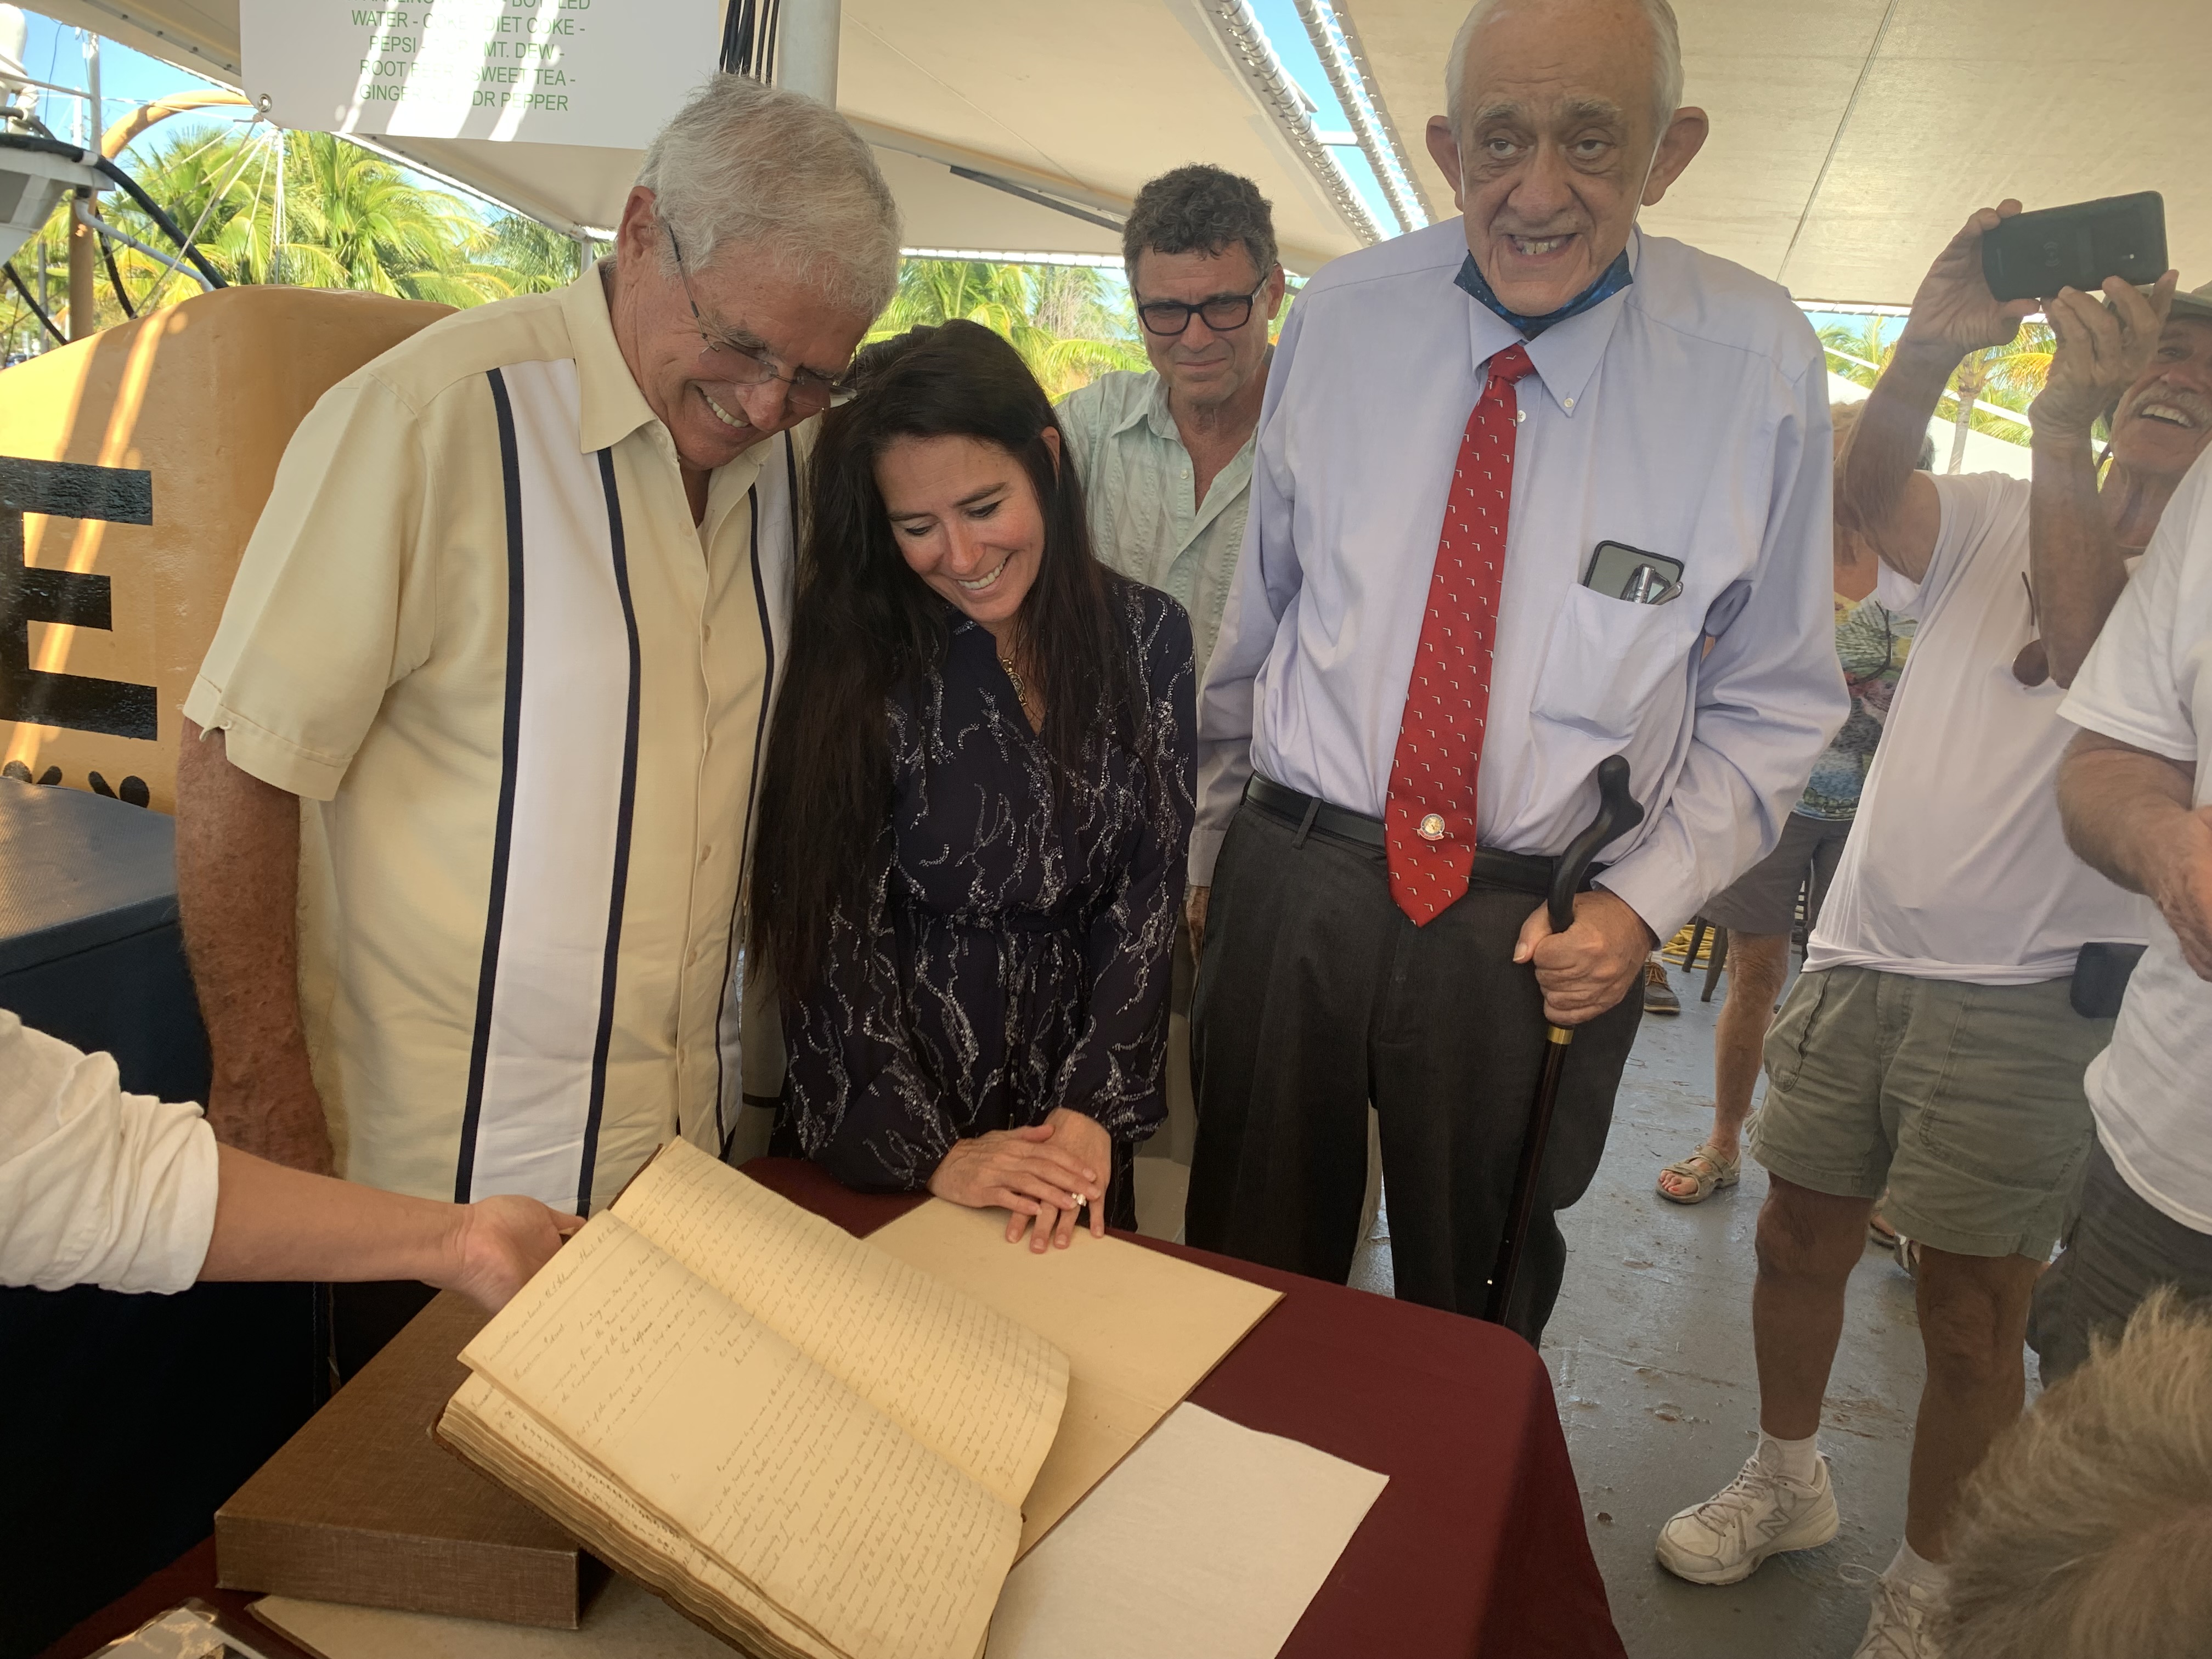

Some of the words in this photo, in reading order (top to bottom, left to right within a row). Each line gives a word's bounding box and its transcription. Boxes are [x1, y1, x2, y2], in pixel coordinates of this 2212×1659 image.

[352, 10, 408, 27] WATER
[485, 16, 522, 32] DIET
[527, 18, 574, 35] COKE
[369, 36, 416, 53] PEPSI
[484, 41, 509, 58] MT.
[516, 42, 554, 60] DEW
[360, 59, 407, 77] ROOT
[471, 66, 528, 83] SWEET
[534, 69, 566, 86] TEA
[360, 84, 421, 101] GINGER
[472, 91, 495, 107] DR
[501, 92, 568, 111] PEPPER
